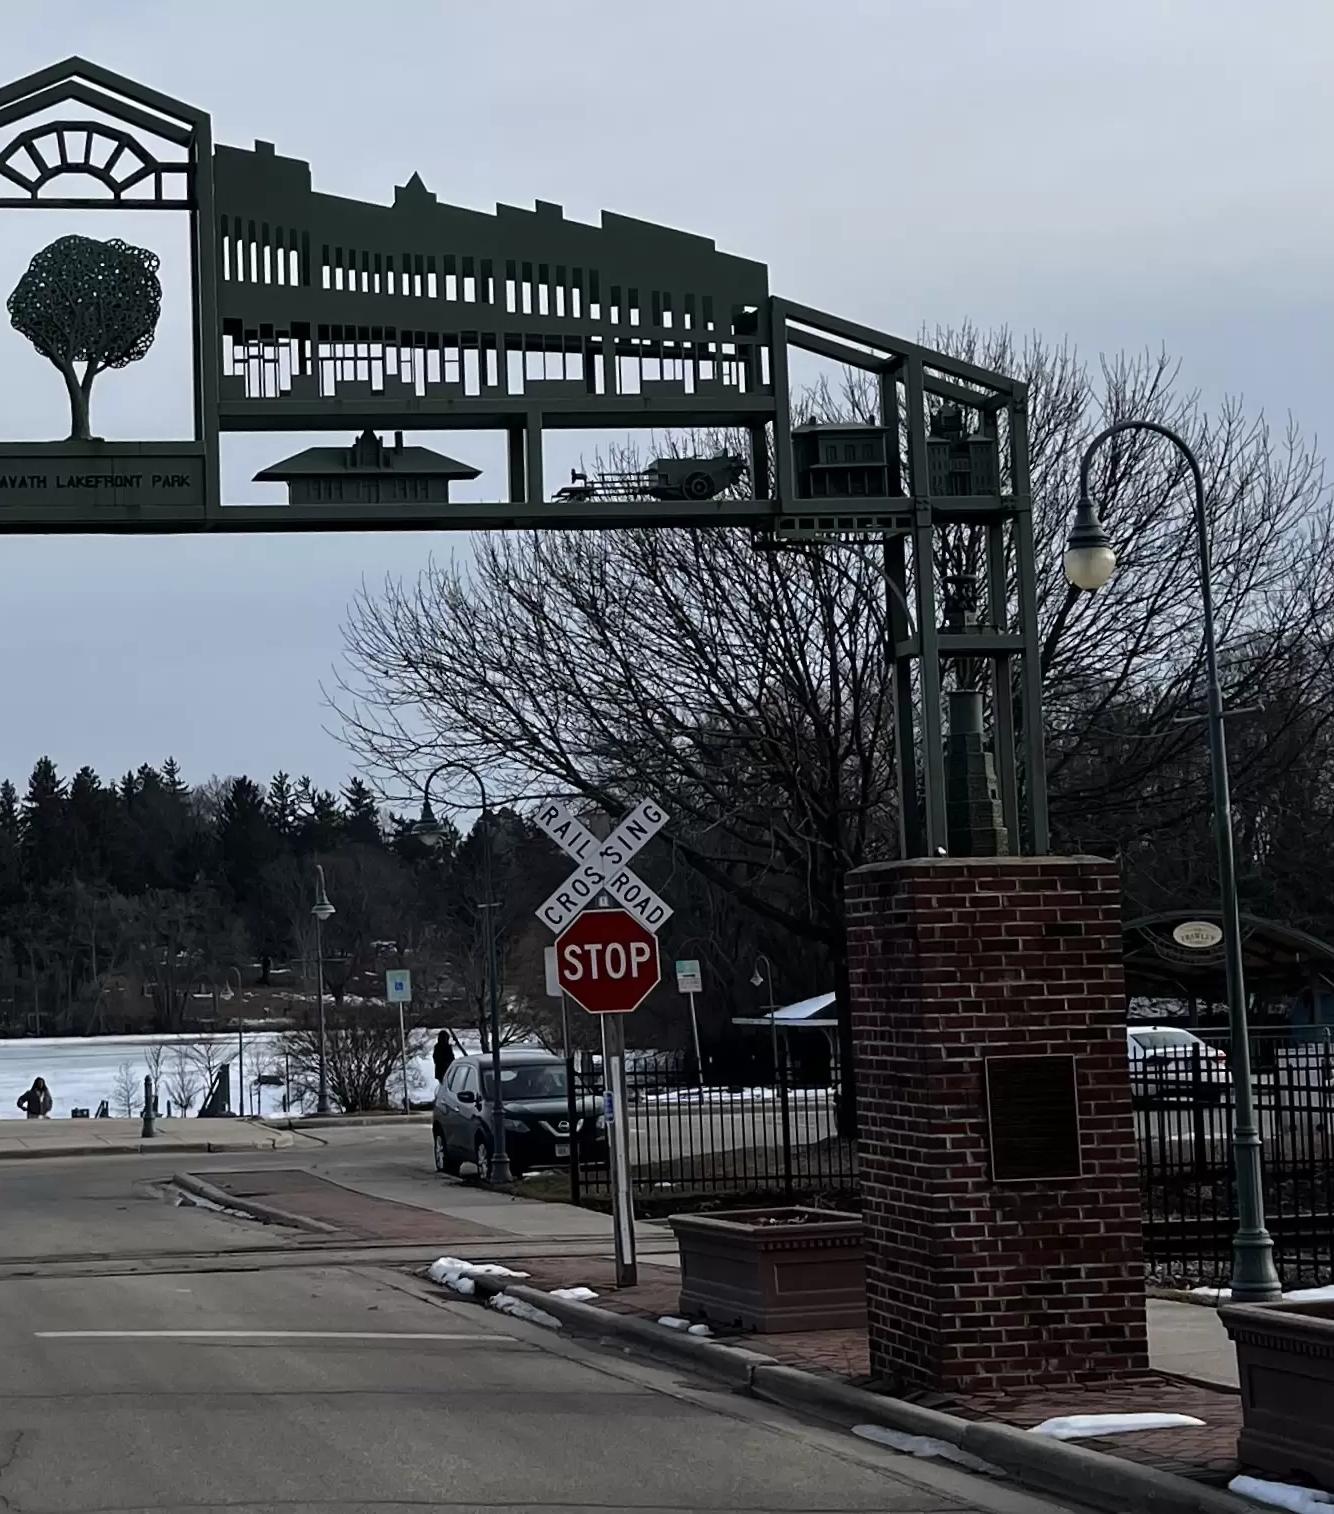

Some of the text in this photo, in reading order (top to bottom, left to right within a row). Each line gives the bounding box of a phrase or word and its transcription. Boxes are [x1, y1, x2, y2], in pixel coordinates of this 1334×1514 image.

[56, 475, 143, 488] LAKEFRONT
[152, 474, 191, 488] PARK
[540, 806, 664, 924] RAIL ROAD
[563, 942, 651, 981] STOP
